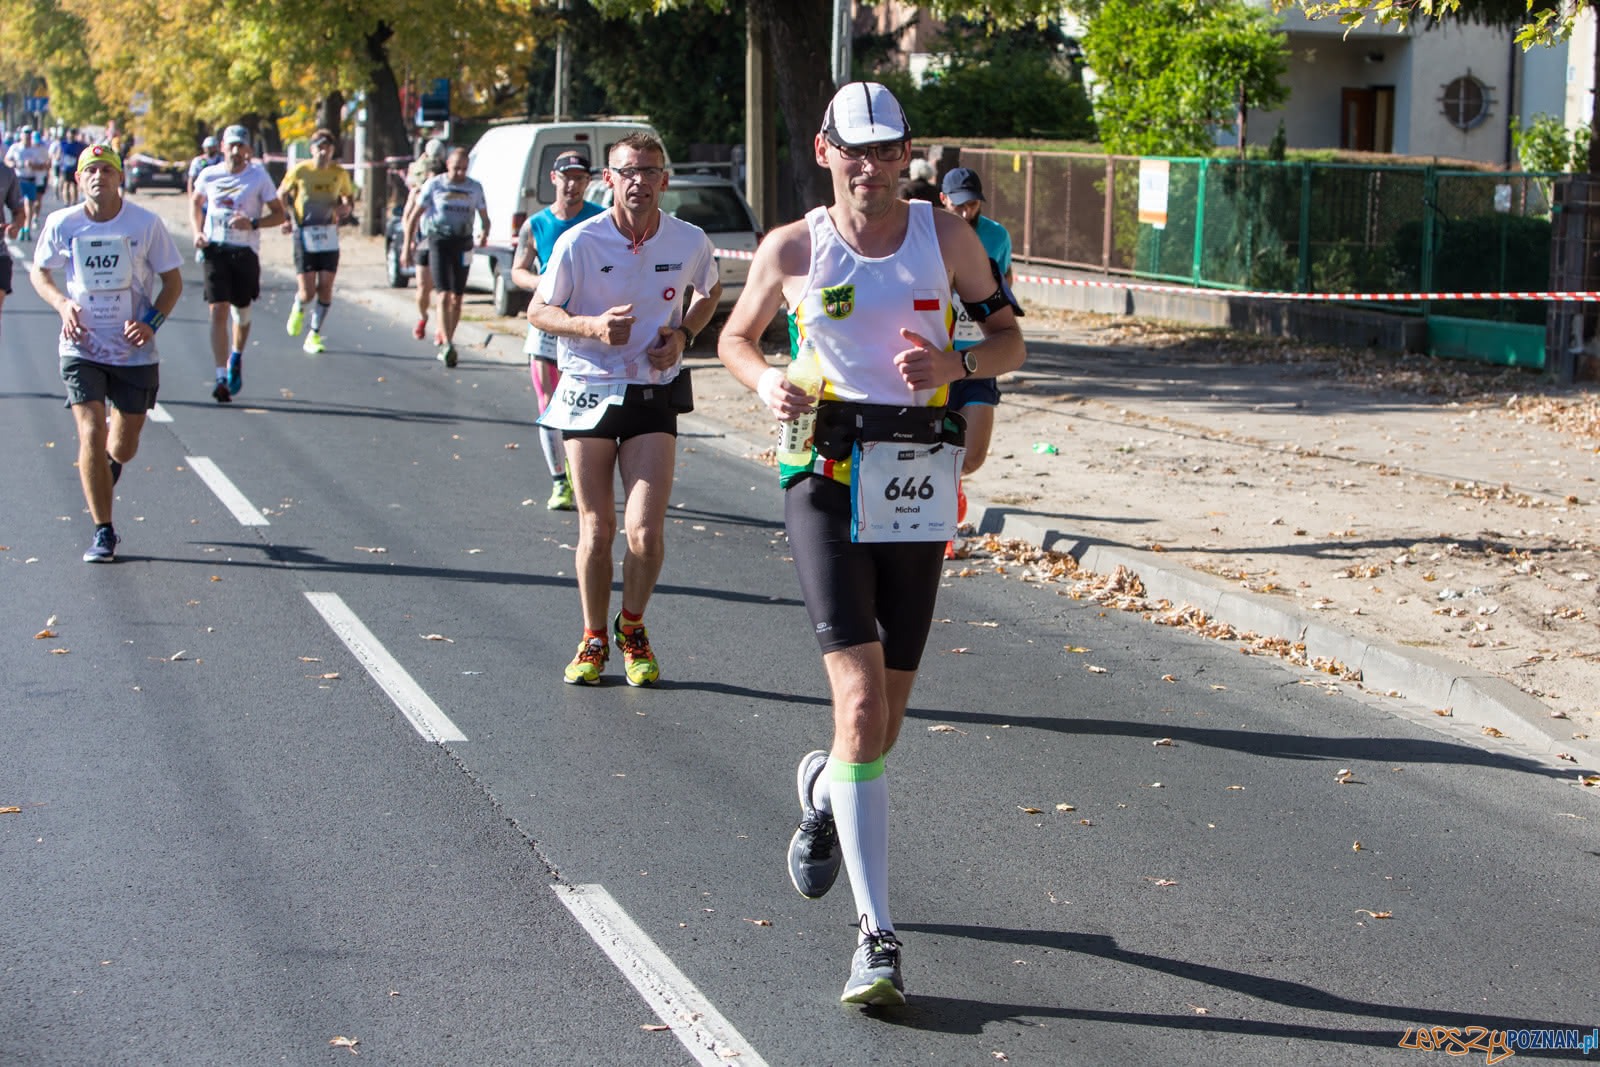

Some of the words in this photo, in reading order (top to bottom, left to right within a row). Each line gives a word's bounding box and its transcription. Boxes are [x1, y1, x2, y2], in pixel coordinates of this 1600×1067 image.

[85, 254, 120, 269] 4167
[600, 265, 614, 273] 4F
[562, 388, 599, 409] 4365
[884, 475, 934, 501] 646
